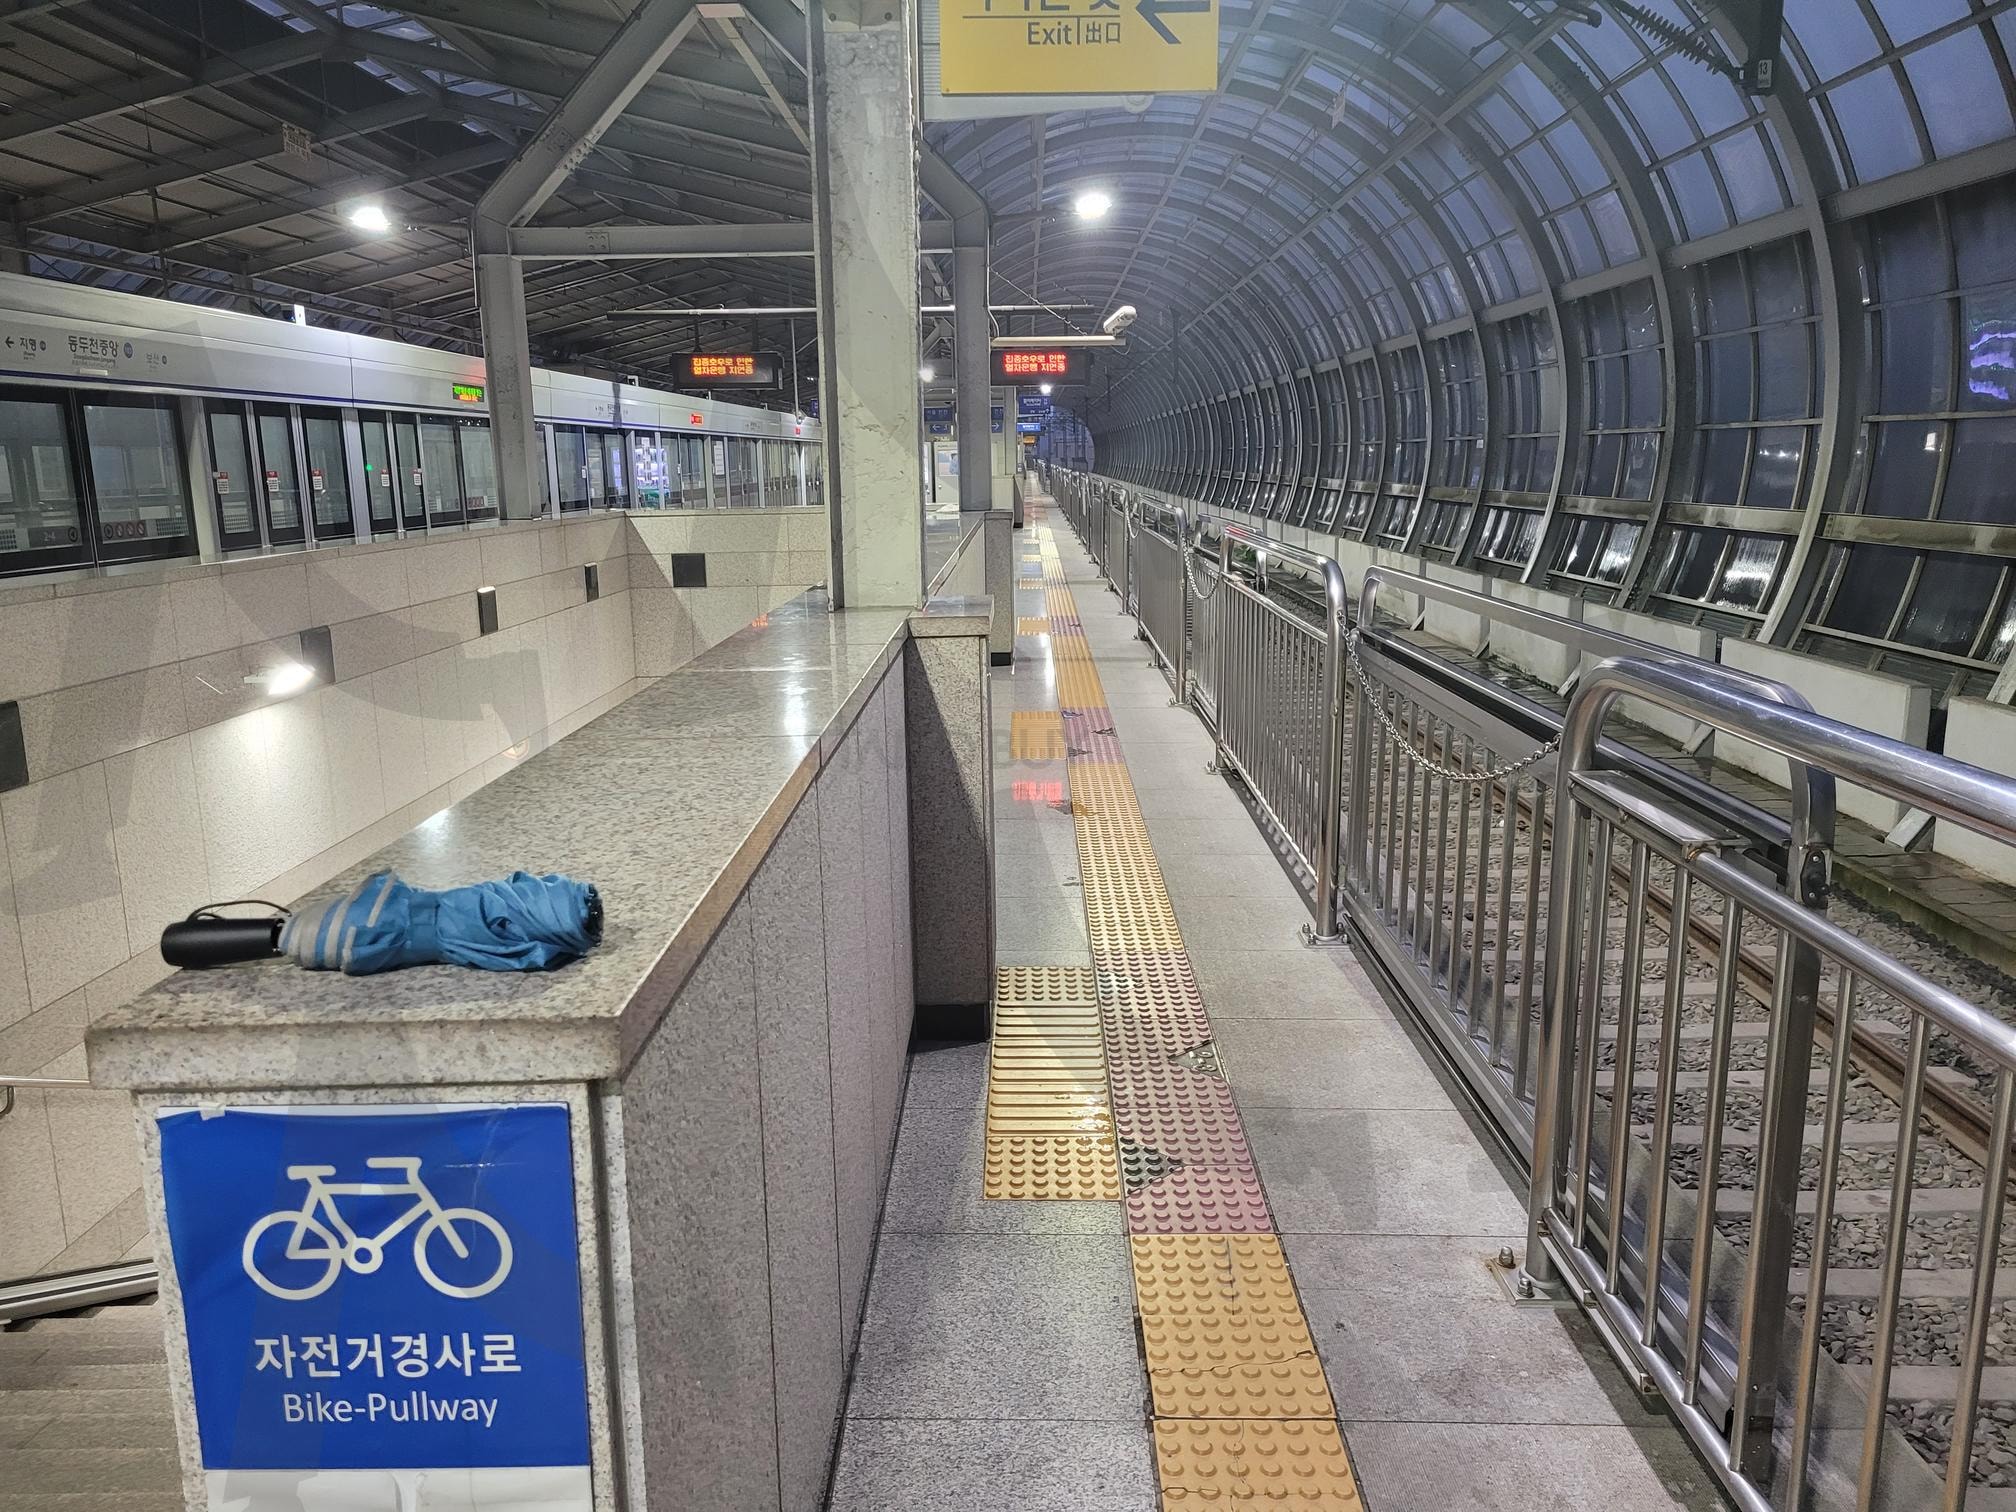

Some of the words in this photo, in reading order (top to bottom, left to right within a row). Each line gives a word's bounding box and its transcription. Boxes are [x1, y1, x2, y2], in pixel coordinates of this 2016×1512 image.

[1027, 21, 1072, 45] Exit
[1085, 21, 1121, 44] 出口
[68, 335, 119, 358] 동두천중앙
[254, 1332, 522, 1378] 자전거경사로
[283, 1392, 498, 1427] Bike-Pullway
